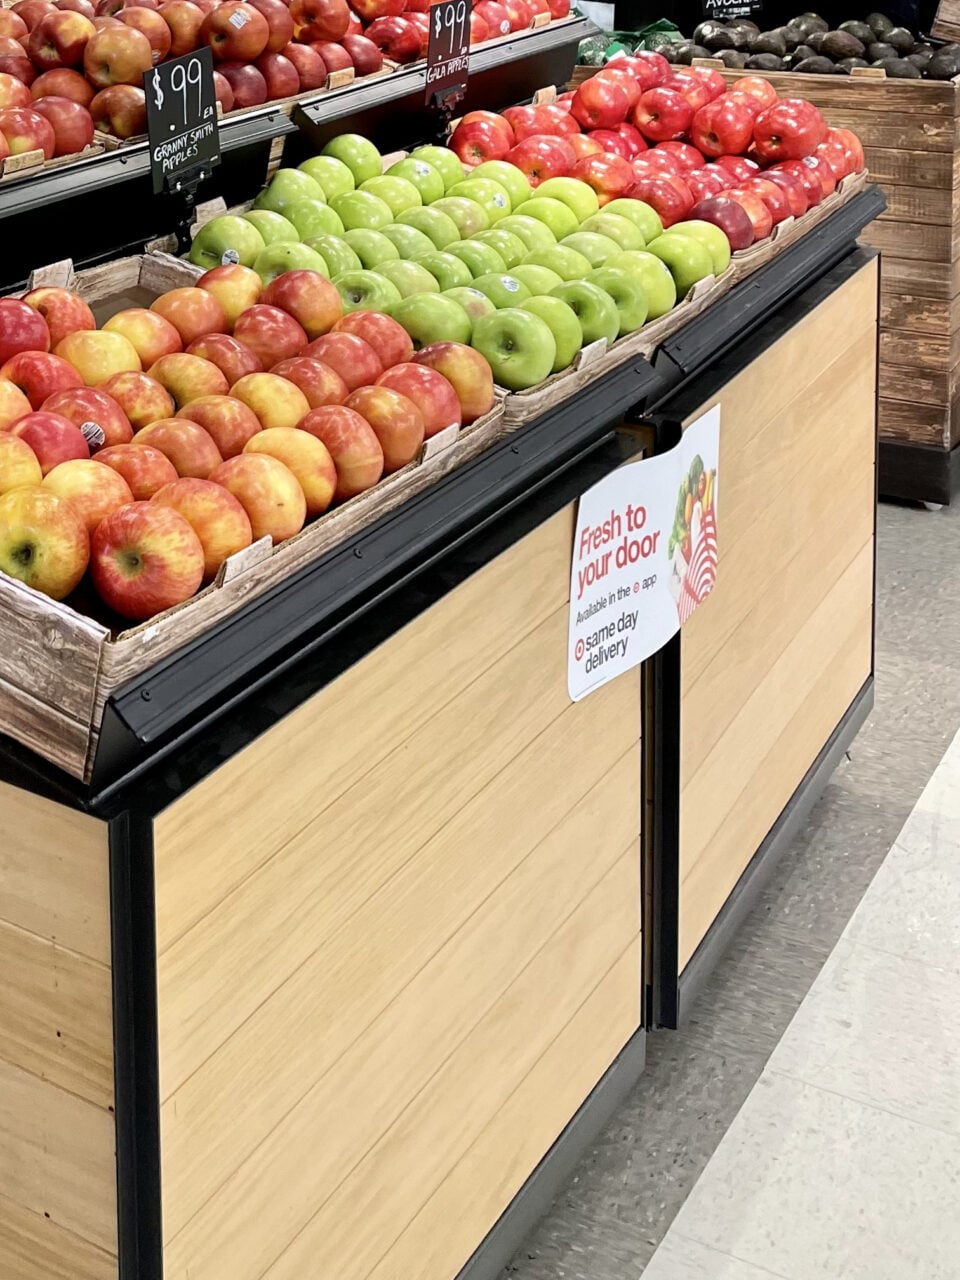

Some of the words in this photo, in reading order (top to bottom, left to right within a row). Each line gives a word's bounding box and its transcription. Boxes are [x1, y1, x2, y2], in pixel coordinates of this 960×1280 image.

[427, 66, 446, 83] GALA
[447, 55, 469, 75] APPLES
[203, 106, 214, 119] EA
[154, 136, 188, 161] GRANNY
[190, 123, 214, 145] SMITH
[162, 145, 198, 172] APPLES
[579, 509, 621, 560] Fresh
[626, 504, 646, 532] to
[578, 551, 612, 600] your
[616, 530, 661, 569] door
[576, 597, 607, 626] Available
[608, 592, 616, 605] in
[617, 586, 631, 600] the
[642, 574, 657, 590] app
[586, 622, 616, 651] same
[617, 610, 639, 632] day
[586, 636, 629, 673] delivery
